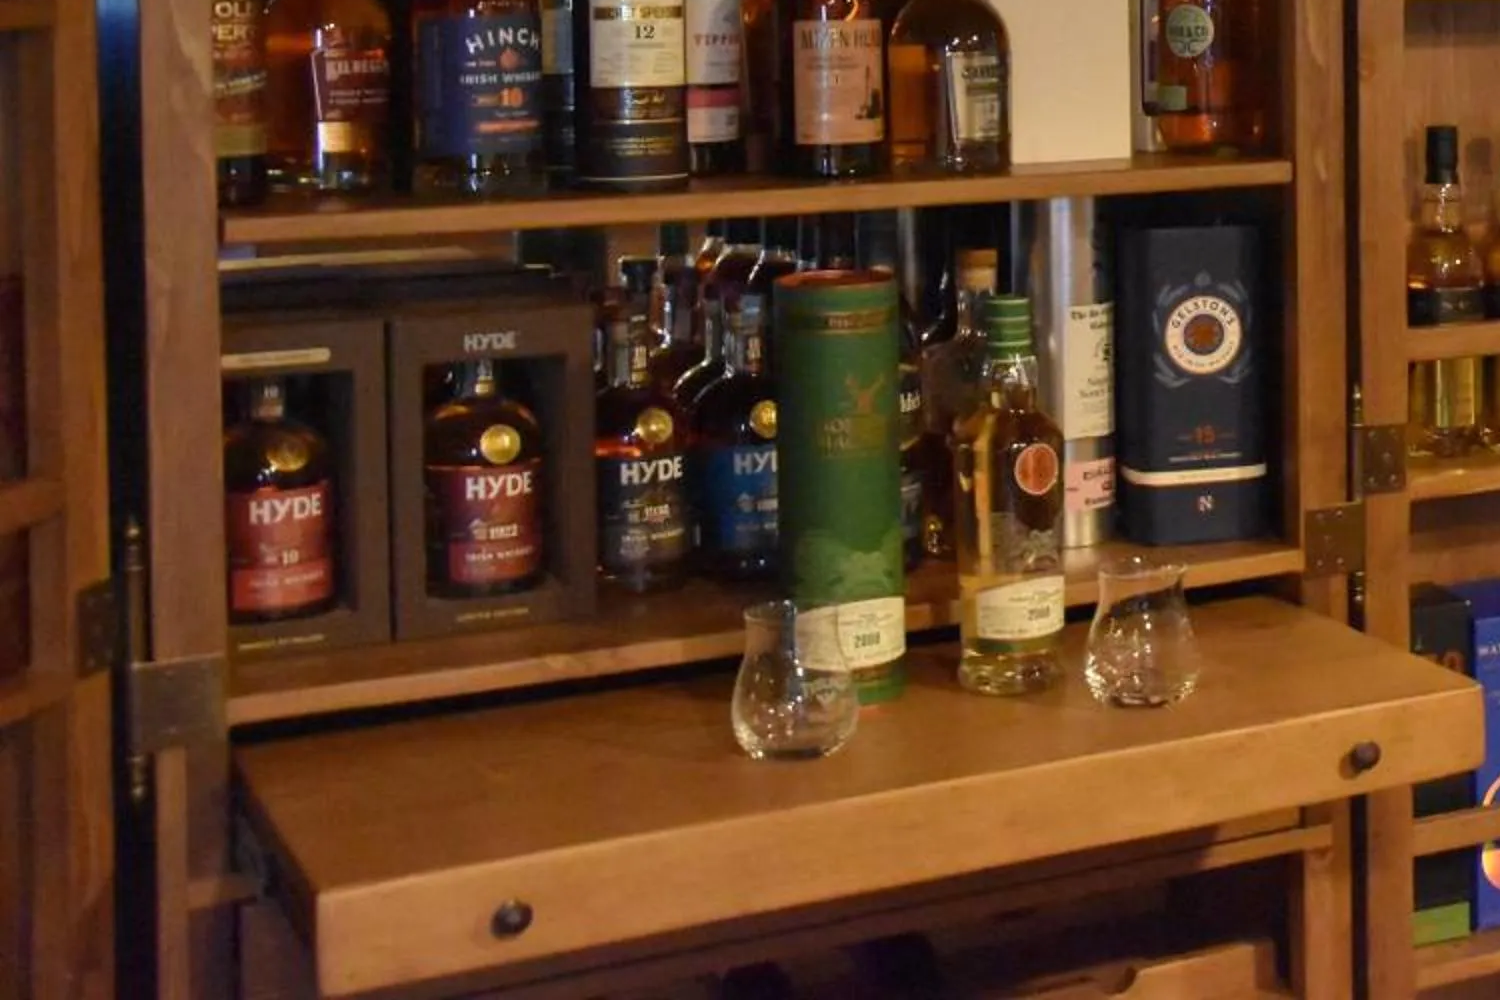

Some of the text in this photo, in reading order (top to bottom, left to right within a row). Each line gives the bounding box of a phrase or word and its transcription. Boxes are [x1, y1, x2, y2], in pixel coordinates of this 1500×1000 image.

[465, 26, 541, 54] HINCH
[635, 24, 656, 40] 12
[463, 330, 517, 352] HYDE
[619, 456, 683, 486] HYDE
[733, 450, 777, 475] HY
[465, 471, 533, 501] HYDE
[249, 493, 322, 525] HYDE
